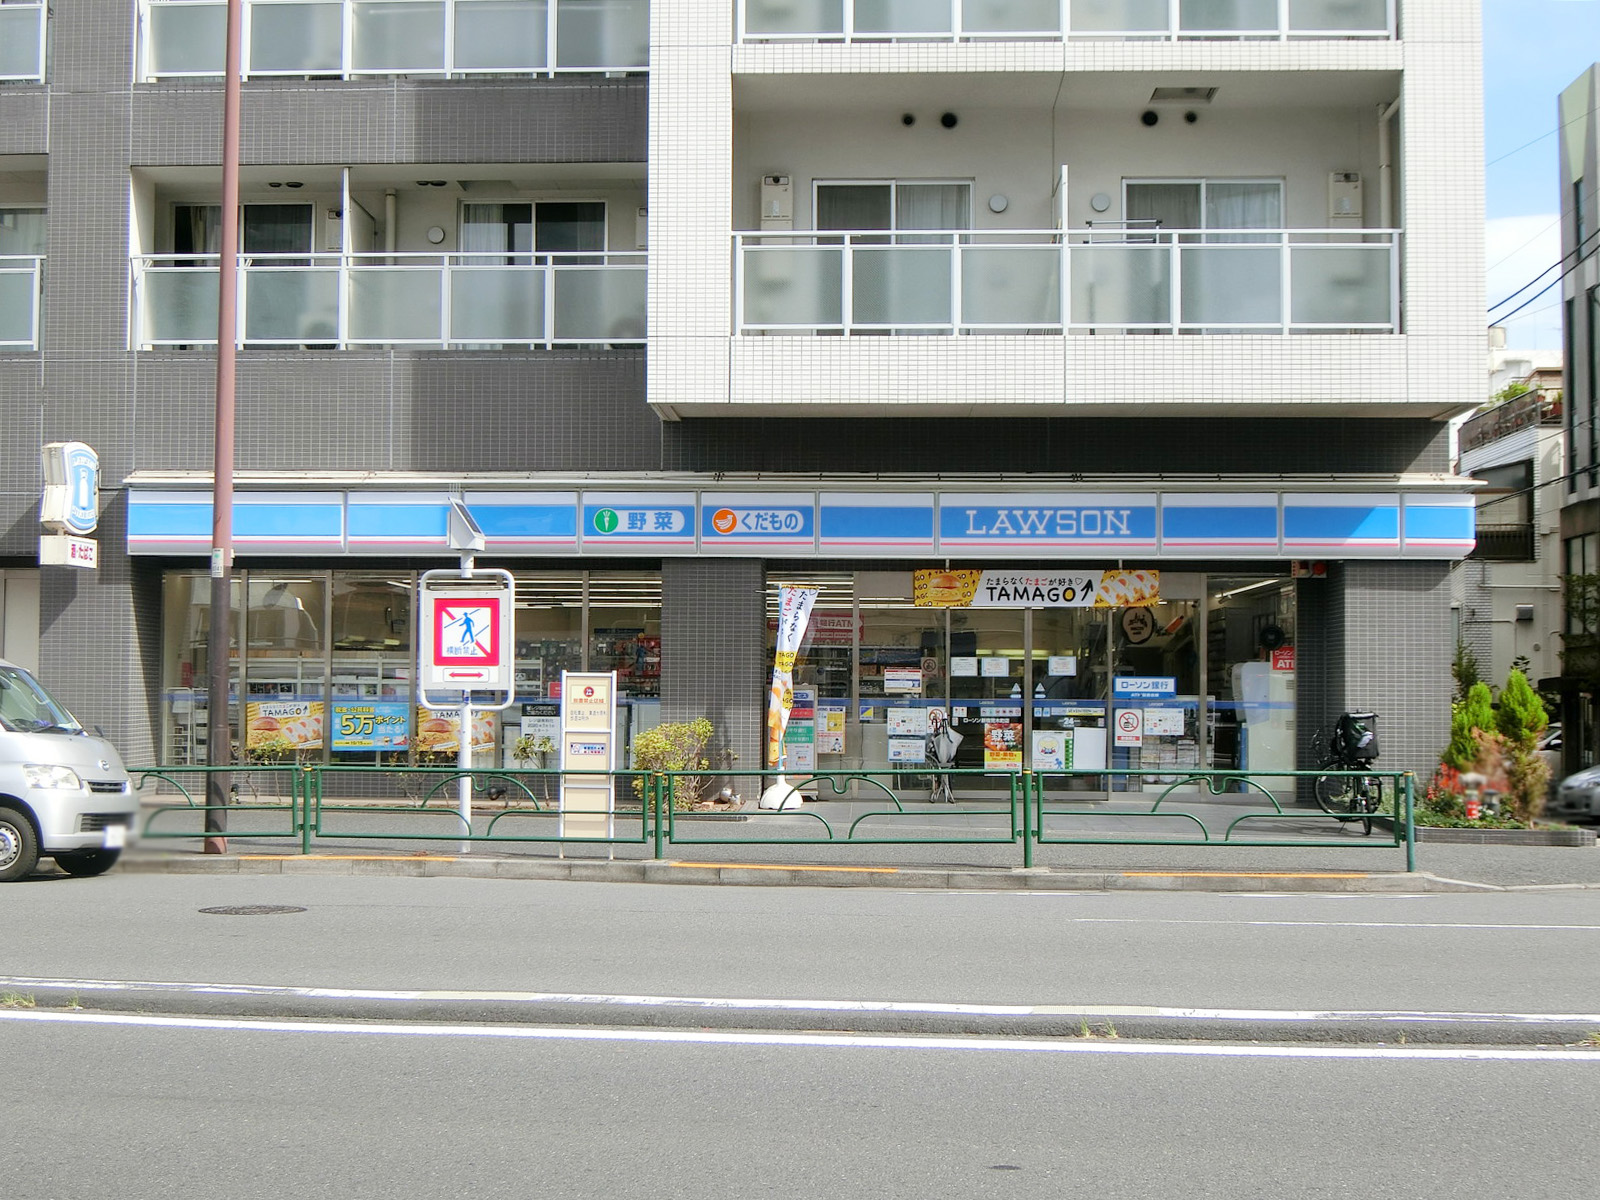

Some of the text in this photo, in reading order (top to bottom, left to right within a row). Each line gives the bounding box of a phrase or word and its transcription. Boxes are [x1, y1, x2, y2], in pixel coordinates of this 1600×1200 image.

[627, 511, 674, 531] 野菜
[741, 512, 798, 531] くだもの
[966, 510, 1131, 535] LAWSON
[986, 586, 1076, 603] TAMAGO
[788, 590, 808, 642] たまらなく
[446, 646, 478, 656] 横断禁止
[1277, 659, 1294, 668] AT
[1121, 681, 1169, 690] ローソン銀行
[262, 707, 302, 717] TAMAGO
[341, 714, 376, 735] 5万
[375, 715, 406, 724] ポイント
